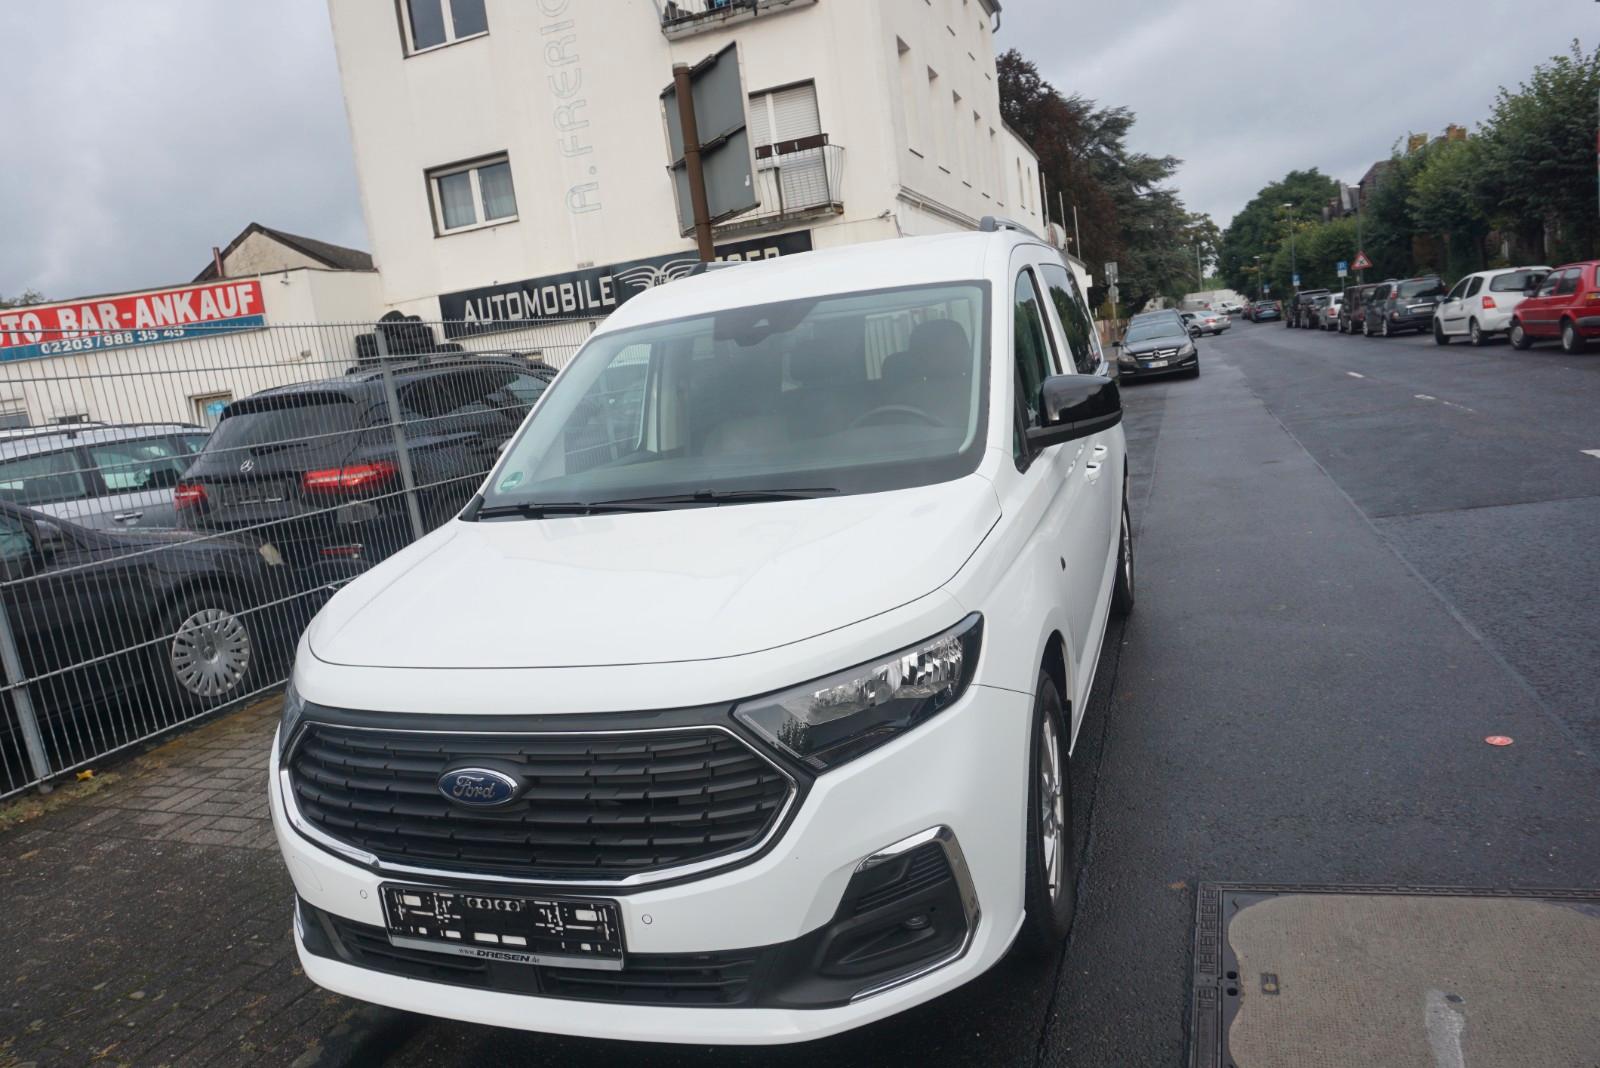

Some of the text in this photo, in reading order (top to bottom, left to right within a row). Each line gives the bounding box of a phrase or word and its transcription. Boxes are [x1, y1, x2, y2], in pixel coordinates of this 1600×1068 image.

[0, 284, 254, 345] TO BAR-ANKAUF
[464, 276, 616, 327] AUTOMOBILE
[453, 775, 496, 799] Ford
